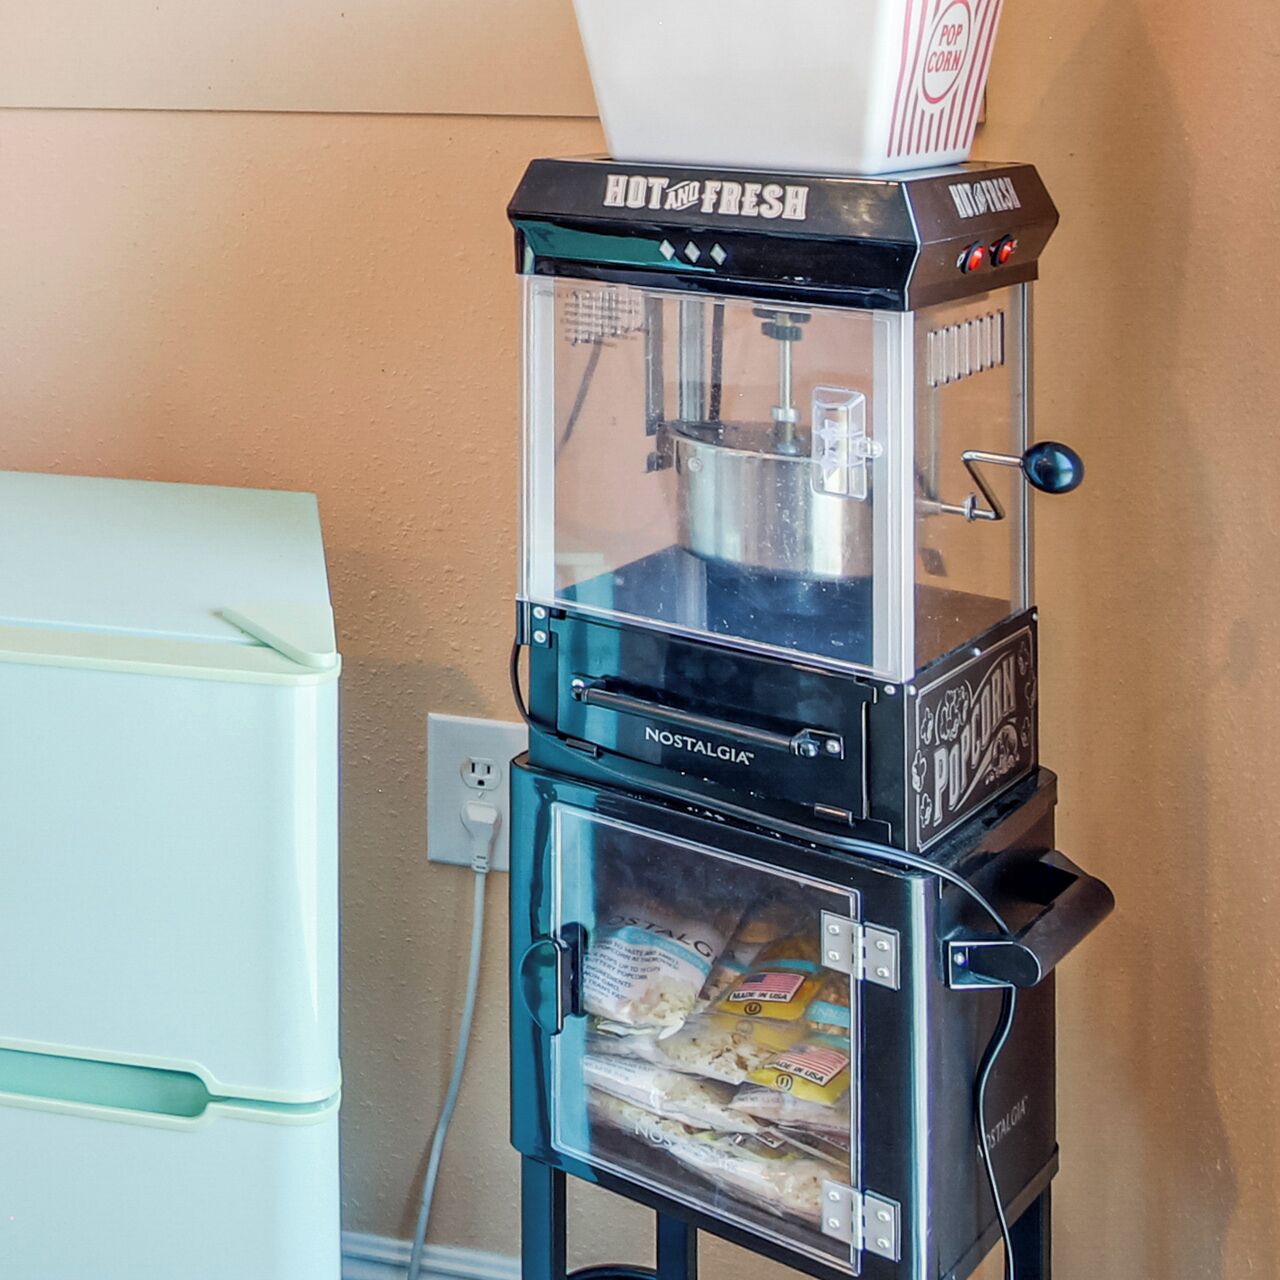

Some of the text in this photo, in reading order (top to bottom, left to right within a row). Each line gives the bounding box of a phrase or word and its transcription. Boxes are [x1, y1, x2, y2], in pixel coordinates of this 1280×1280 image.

[939, 24, 963, 46] POP
[927, 50, 962, 73] CORN
[603, 174, 810, 220] HOT AND FRESH
[933, 656, 1016, 827] POPCORN
[732, 991, 756, 1000] MADE
[769, 993, 788, 1001] USA
[804, 1069, 824, 1082] USA
